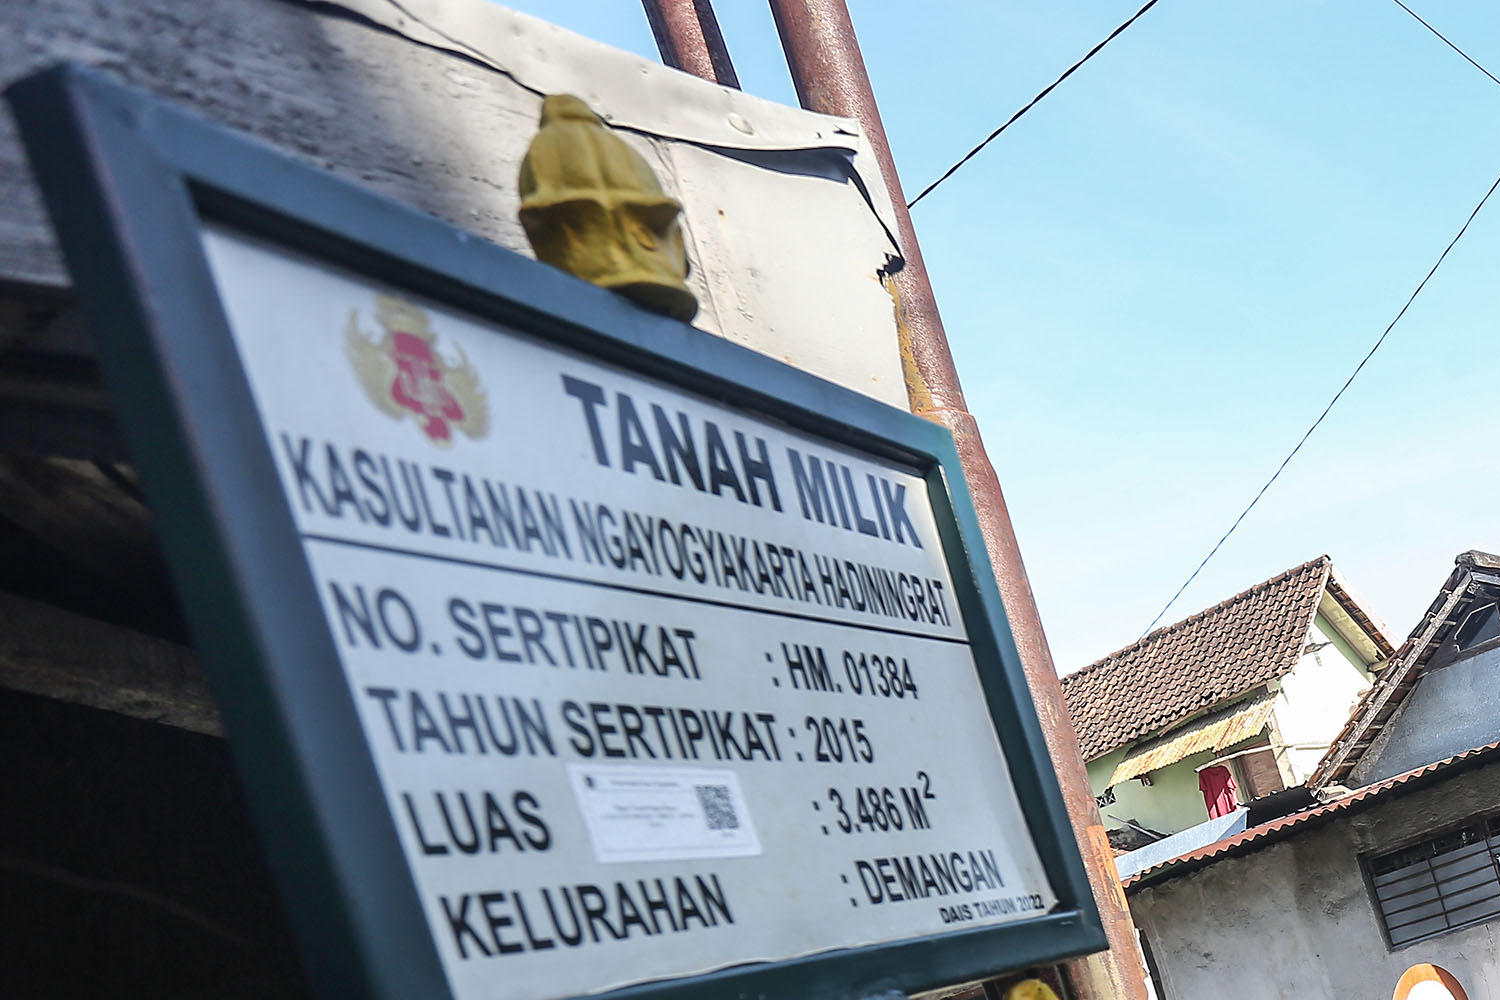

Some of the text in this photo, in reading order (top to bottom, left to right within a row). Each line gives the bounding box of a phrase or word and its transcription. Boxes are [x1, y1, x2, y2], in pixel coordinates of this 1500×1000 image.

[561, 374, 924, 549] TANAH MILIK
[279, 432, 954, 629] KASULTANAN NGAYOGYAKARTA HADININGRAT
[327, 580, 439, 656] NO.
[456, 601, 702, 681] SERTIPIKAT
[846, 656, 919, 700] 01384
[367, 687, 557, 757] TAHUN
[564, 701, 785, 763] SERTIPIKAT
[812, 717, 875, 764] 2015
[401, 790, 552, 857] LUAS
[827, 786, 902, 835] 3.486
[439, 874, 735, 960] KELURAHAN
[858, 850, 1005, 905] DEMANGAN
[938, 894, 1045, 924] DAIS TAHUN 2022
